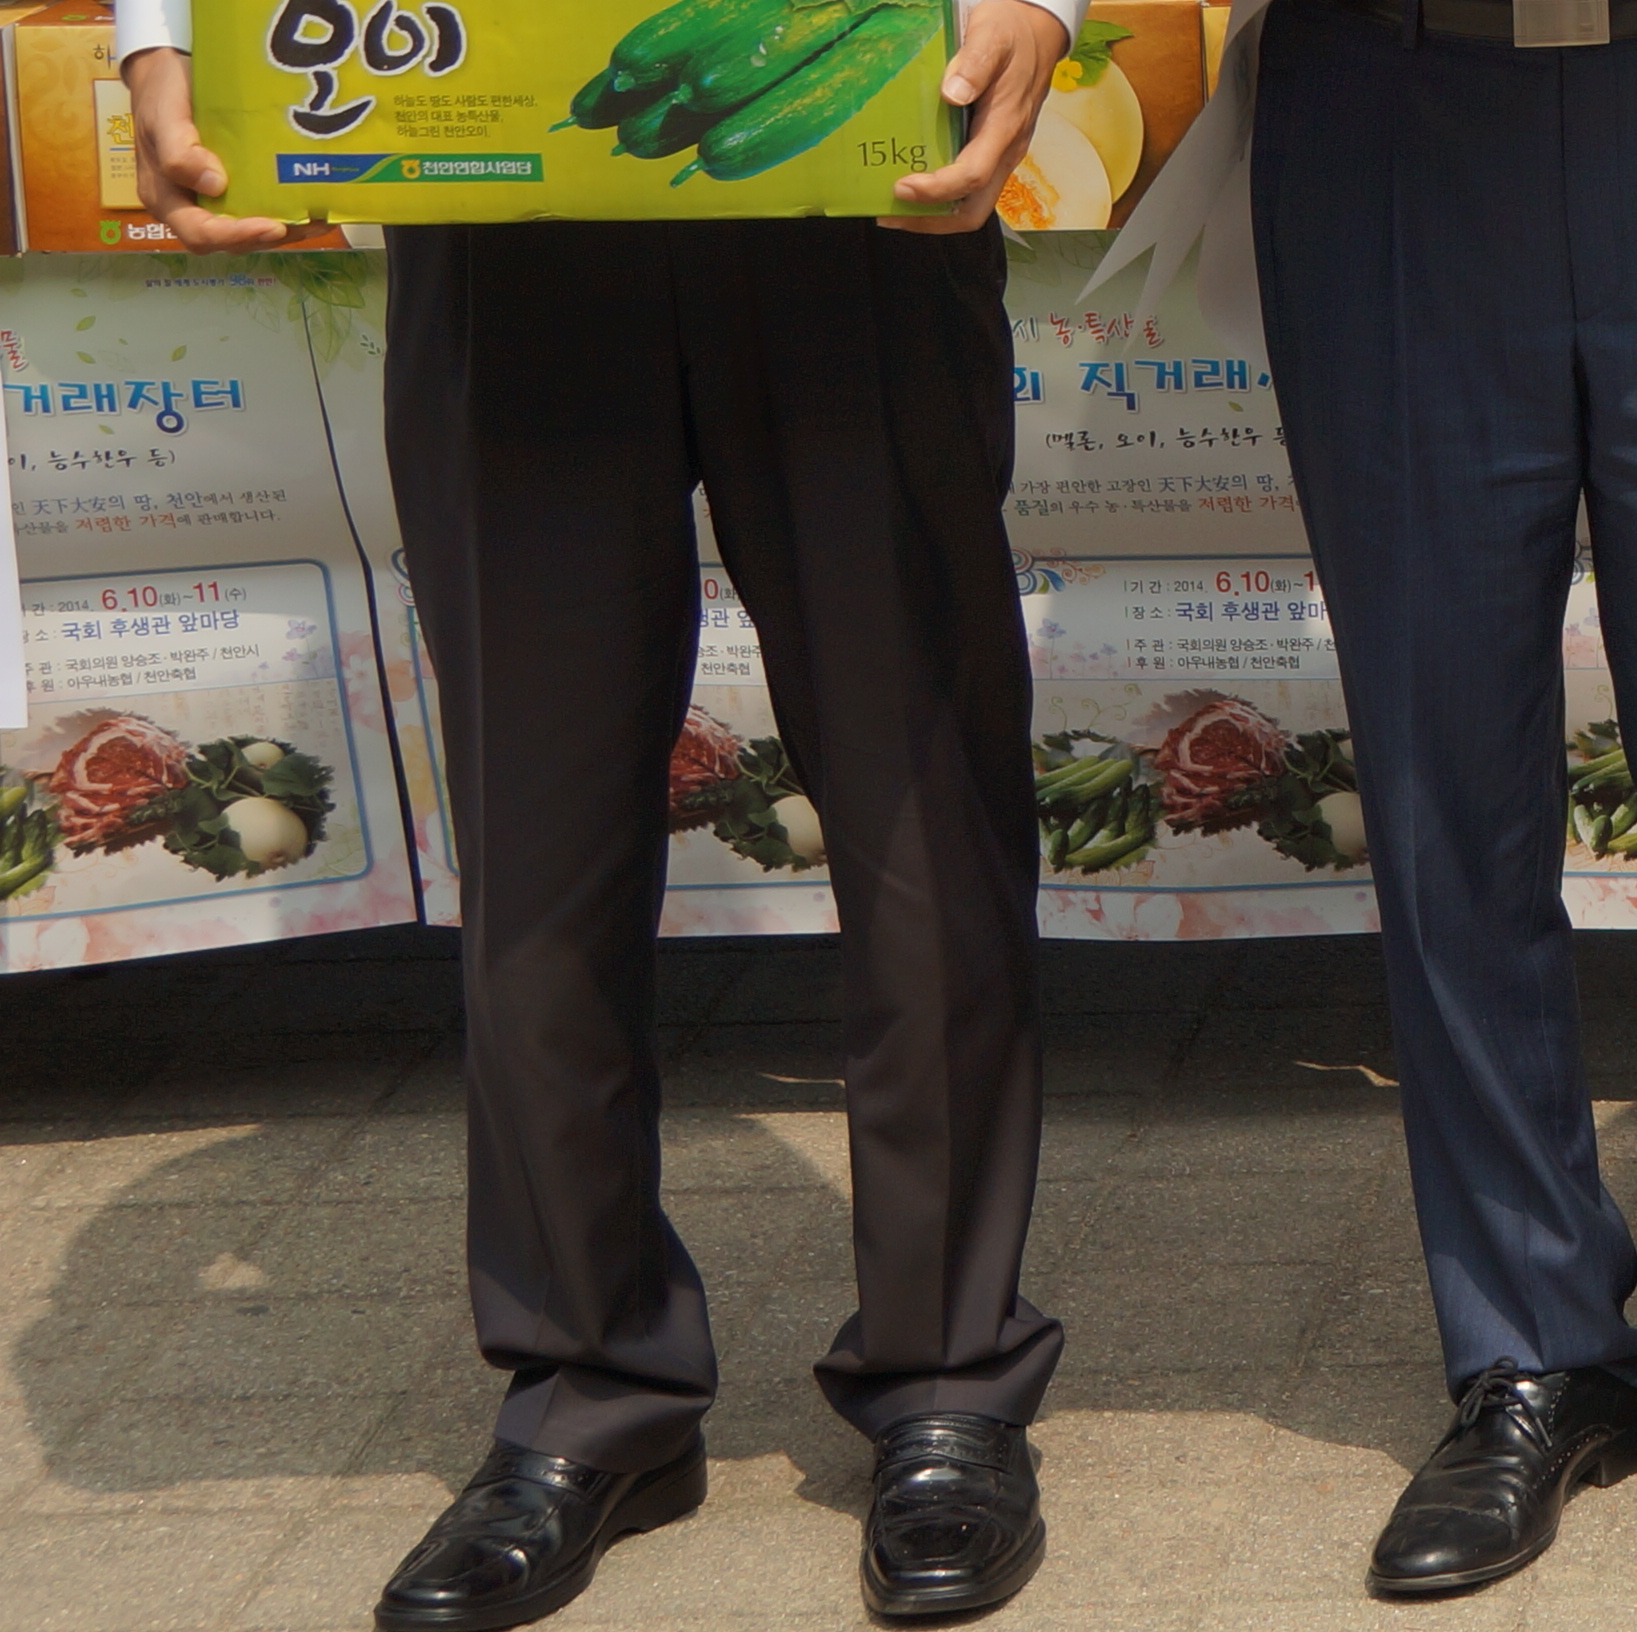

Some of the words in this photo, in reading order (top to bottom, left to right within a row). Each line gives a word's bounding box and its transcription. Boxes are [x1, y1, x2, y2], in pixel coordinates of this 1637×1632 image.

[858, 138, 928, 174] 15kg
[293, 162, 330, 176] NH
[1078, 358, 1273, 411] 직거래
[1175, 427, 1263, 448] 능수한우
[1260, 495, 1300, 513] 가격
[1175, 601, 1214, 622] 국회
[1221, 601, 1280, 622] 후생관
[61, 620, 102, 642] 국회
[109, 617, 171, 638] 후생관
[178, 609, 240, 633] 앞마당
[1177, 638, 1228, 652] 국회의원
[65, 655, 118, 672] 국회의원
[219, 643, 260, 660] 천안시
